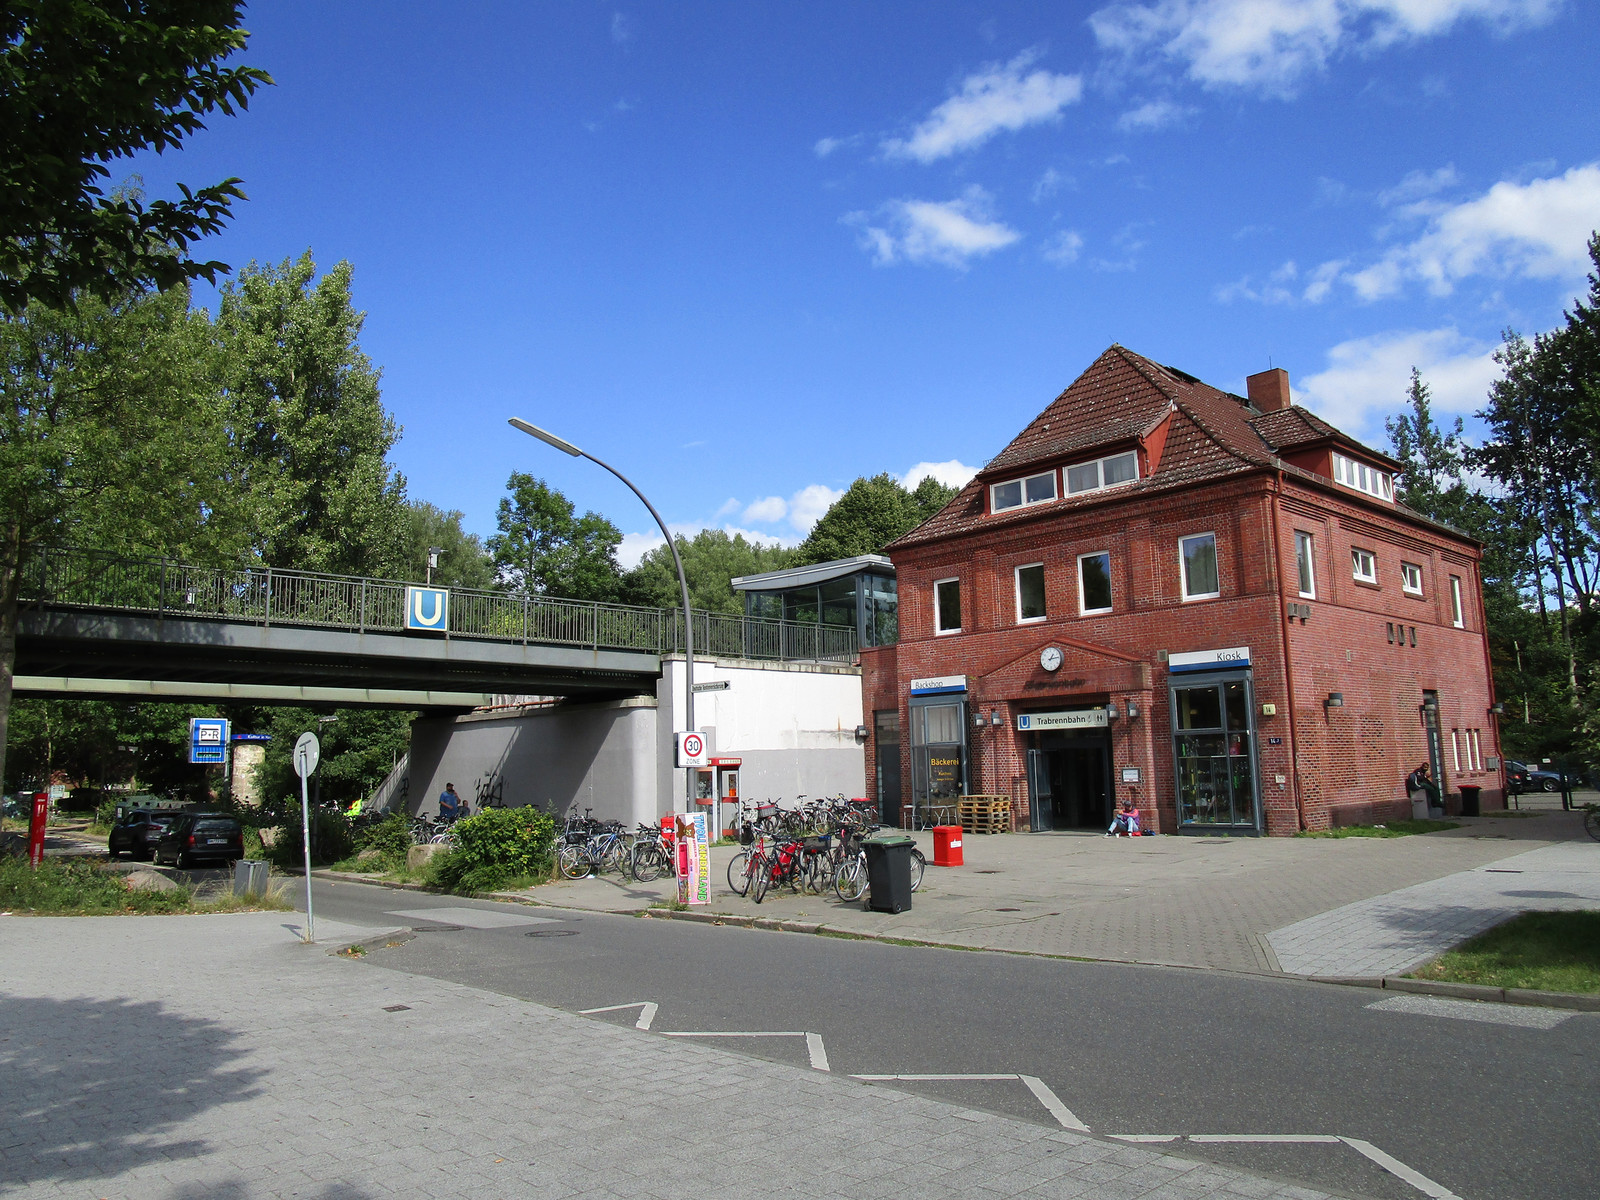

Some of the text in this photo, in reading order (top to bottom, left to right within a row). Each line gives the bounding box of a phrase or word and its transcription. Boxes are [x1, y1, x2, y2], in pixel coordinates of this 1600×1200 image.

[414, 591, 443, 626] U
[1216, 650, 1241, 662] Kiosk
[1020, 716, 1086, 728] U Trabrennbahn
[687, 740, 699, 751] 30
[931, 757, 959, 766] Bäckerei
[693, 814, 708, 901] TIVOLI KINDERLAND
